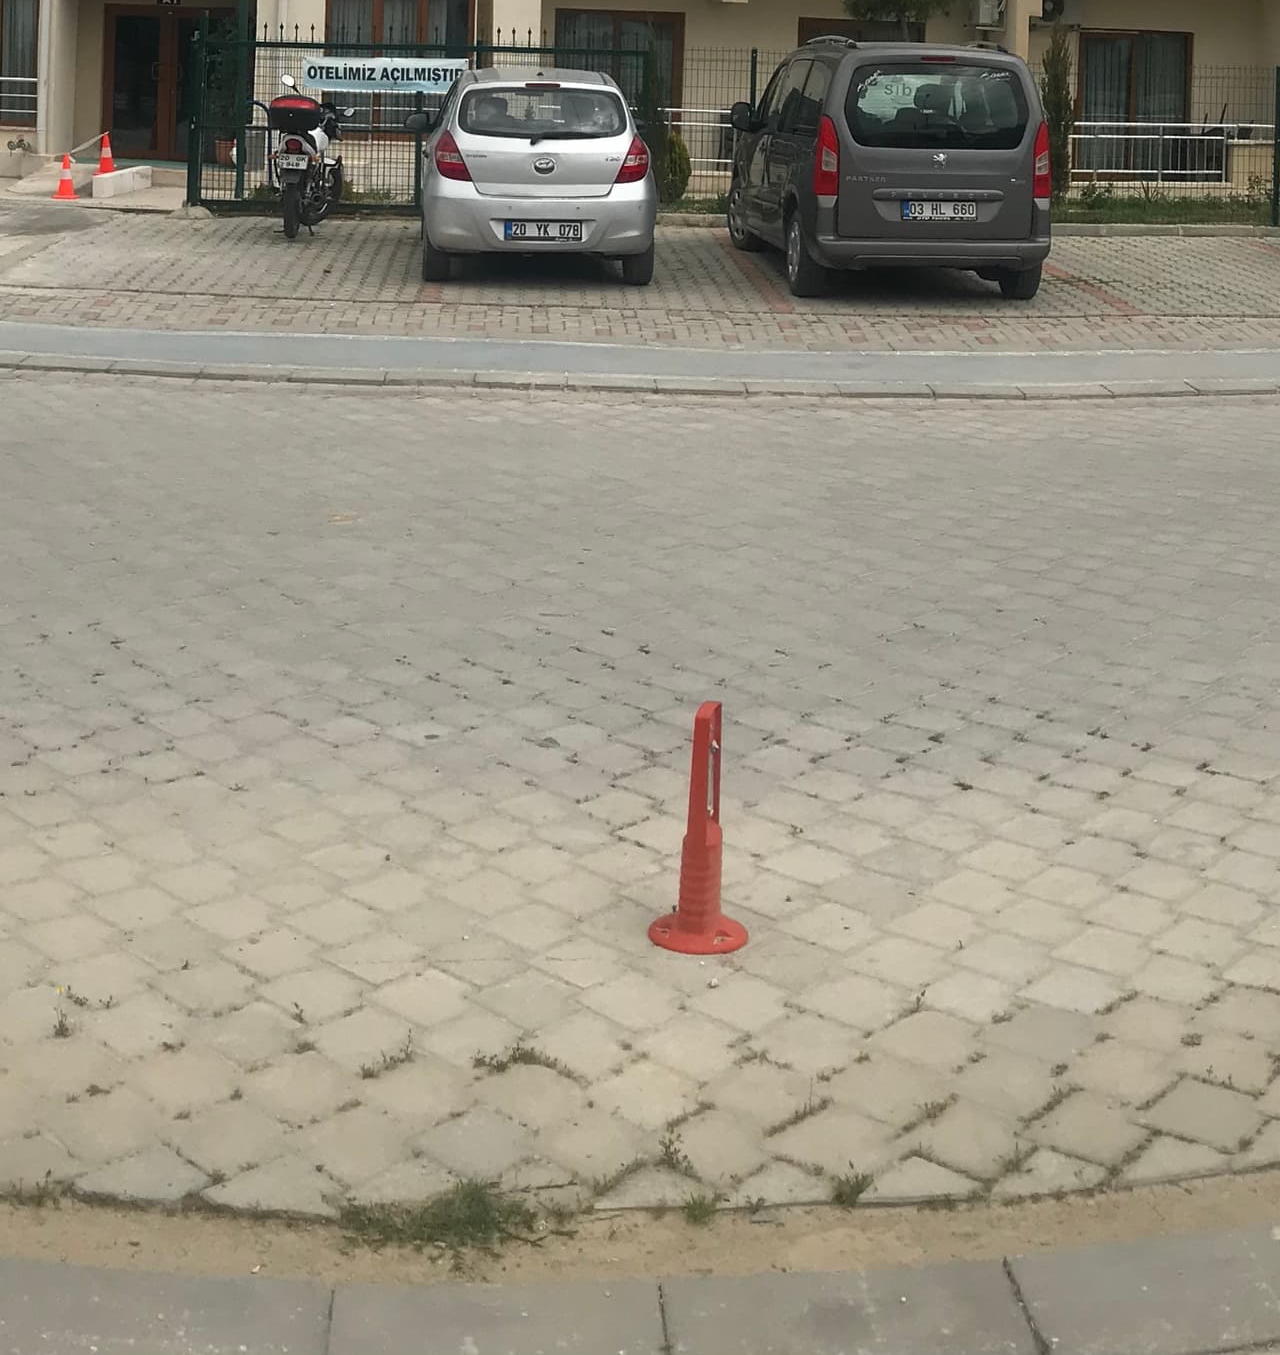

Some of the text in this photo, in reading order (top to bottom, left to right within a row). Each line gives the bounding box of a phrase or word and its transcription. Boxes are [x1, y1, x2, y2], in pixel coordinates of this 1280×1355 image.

[307, 62, 377, 82] OTELİMİZ
[845, 175, 887, 183] PARTNER
[910, 203, 975, 216] 03 HL 660
[513, 223, 579, 236] 20 YK 078
